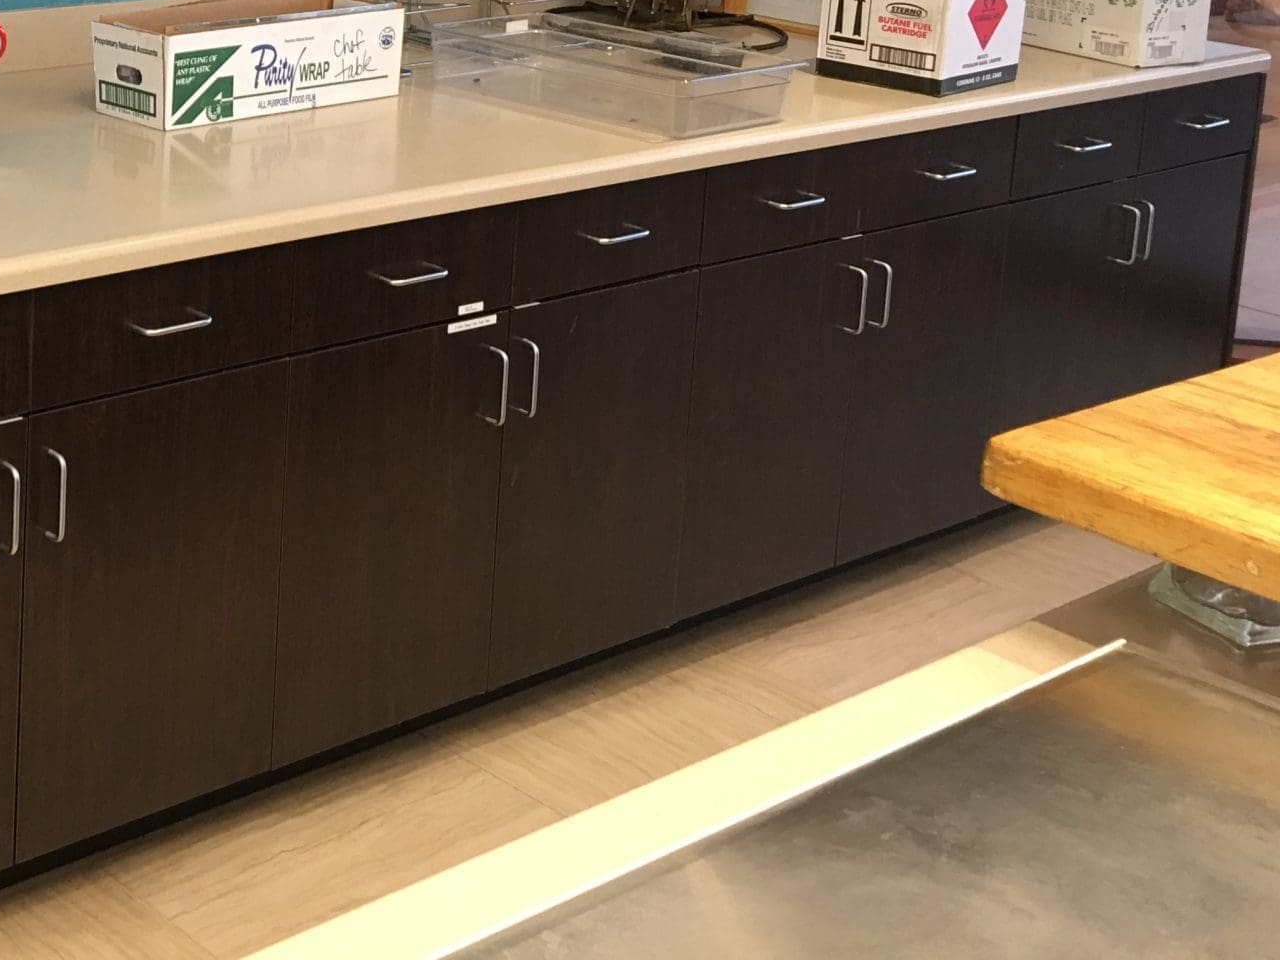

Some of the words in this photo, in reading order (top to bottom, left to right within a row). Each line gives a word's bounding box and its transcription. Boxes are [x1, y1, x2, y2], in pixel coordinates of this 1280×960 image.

[890, 5, 923, 18] STERNO
[878, 15, 911, 29] BUTANE
[913, 19, 933, 32] FUEL
[881, 24, 928, 39] CARTRIDGE
[176, 68, 189, 76] ANY
[189, 65, 212, 74] PLASTIC
[299, 61, 330, 82] WRAP
[258, 100, 267, 109] ALL
[267, 96, 289, 108] PURPOSE
[292, 94, 305, 104] FOOD
